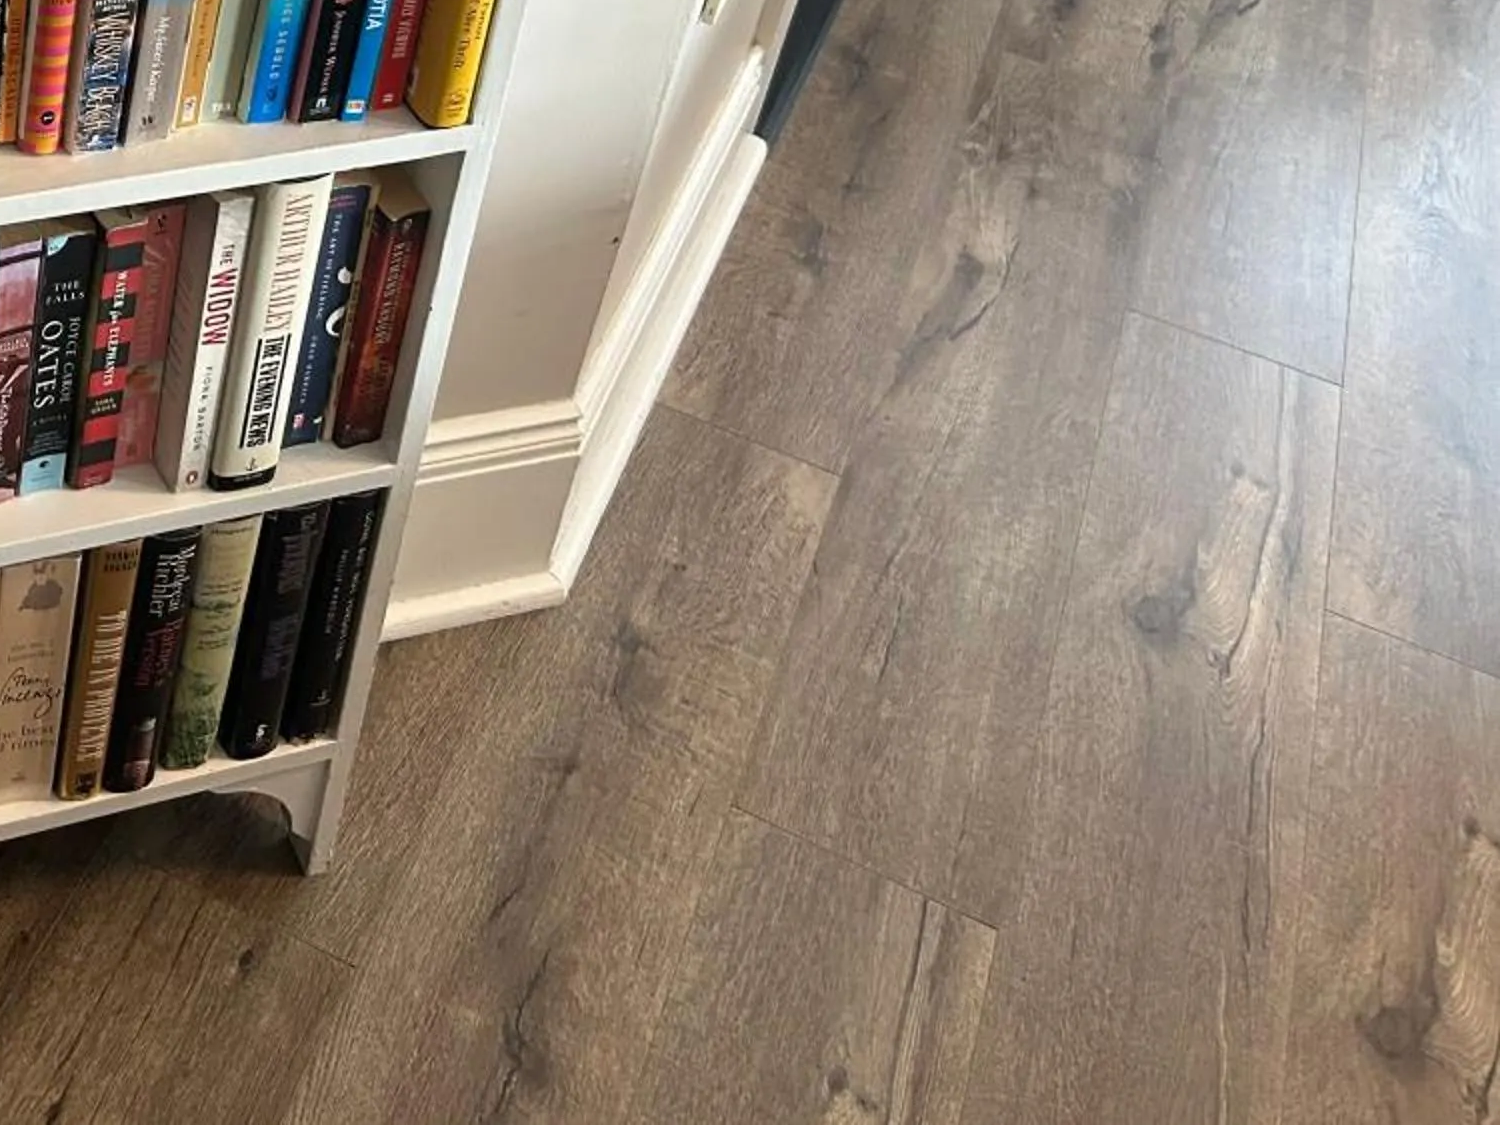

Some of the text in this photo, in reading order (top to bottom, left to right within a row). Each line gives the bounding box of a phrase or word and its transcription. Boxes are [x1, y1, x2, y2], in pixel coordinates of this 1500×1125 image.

[154, 17, 171, 33] My
[269, 30, 290, 80] SEBOLD
[90, 12, 132, 131] WHISKEY BEACH
[45, 291, 85, 306] FALLS
[54, 280, 80, 292] THE
[202, 244, 239, 346] THE WIDOW
[263, 194, 314, 333] ARTHUR HAILEY
[33, 320, 64, 409] OATES
[65, 316, 82, 356] JOYCE
[102, 270, 128, 386] WATER ELEPHANTS
[193, 366, 214, 452] FIONA BARTON
[246, 336, 285, 448] THE EVENING NEWS
